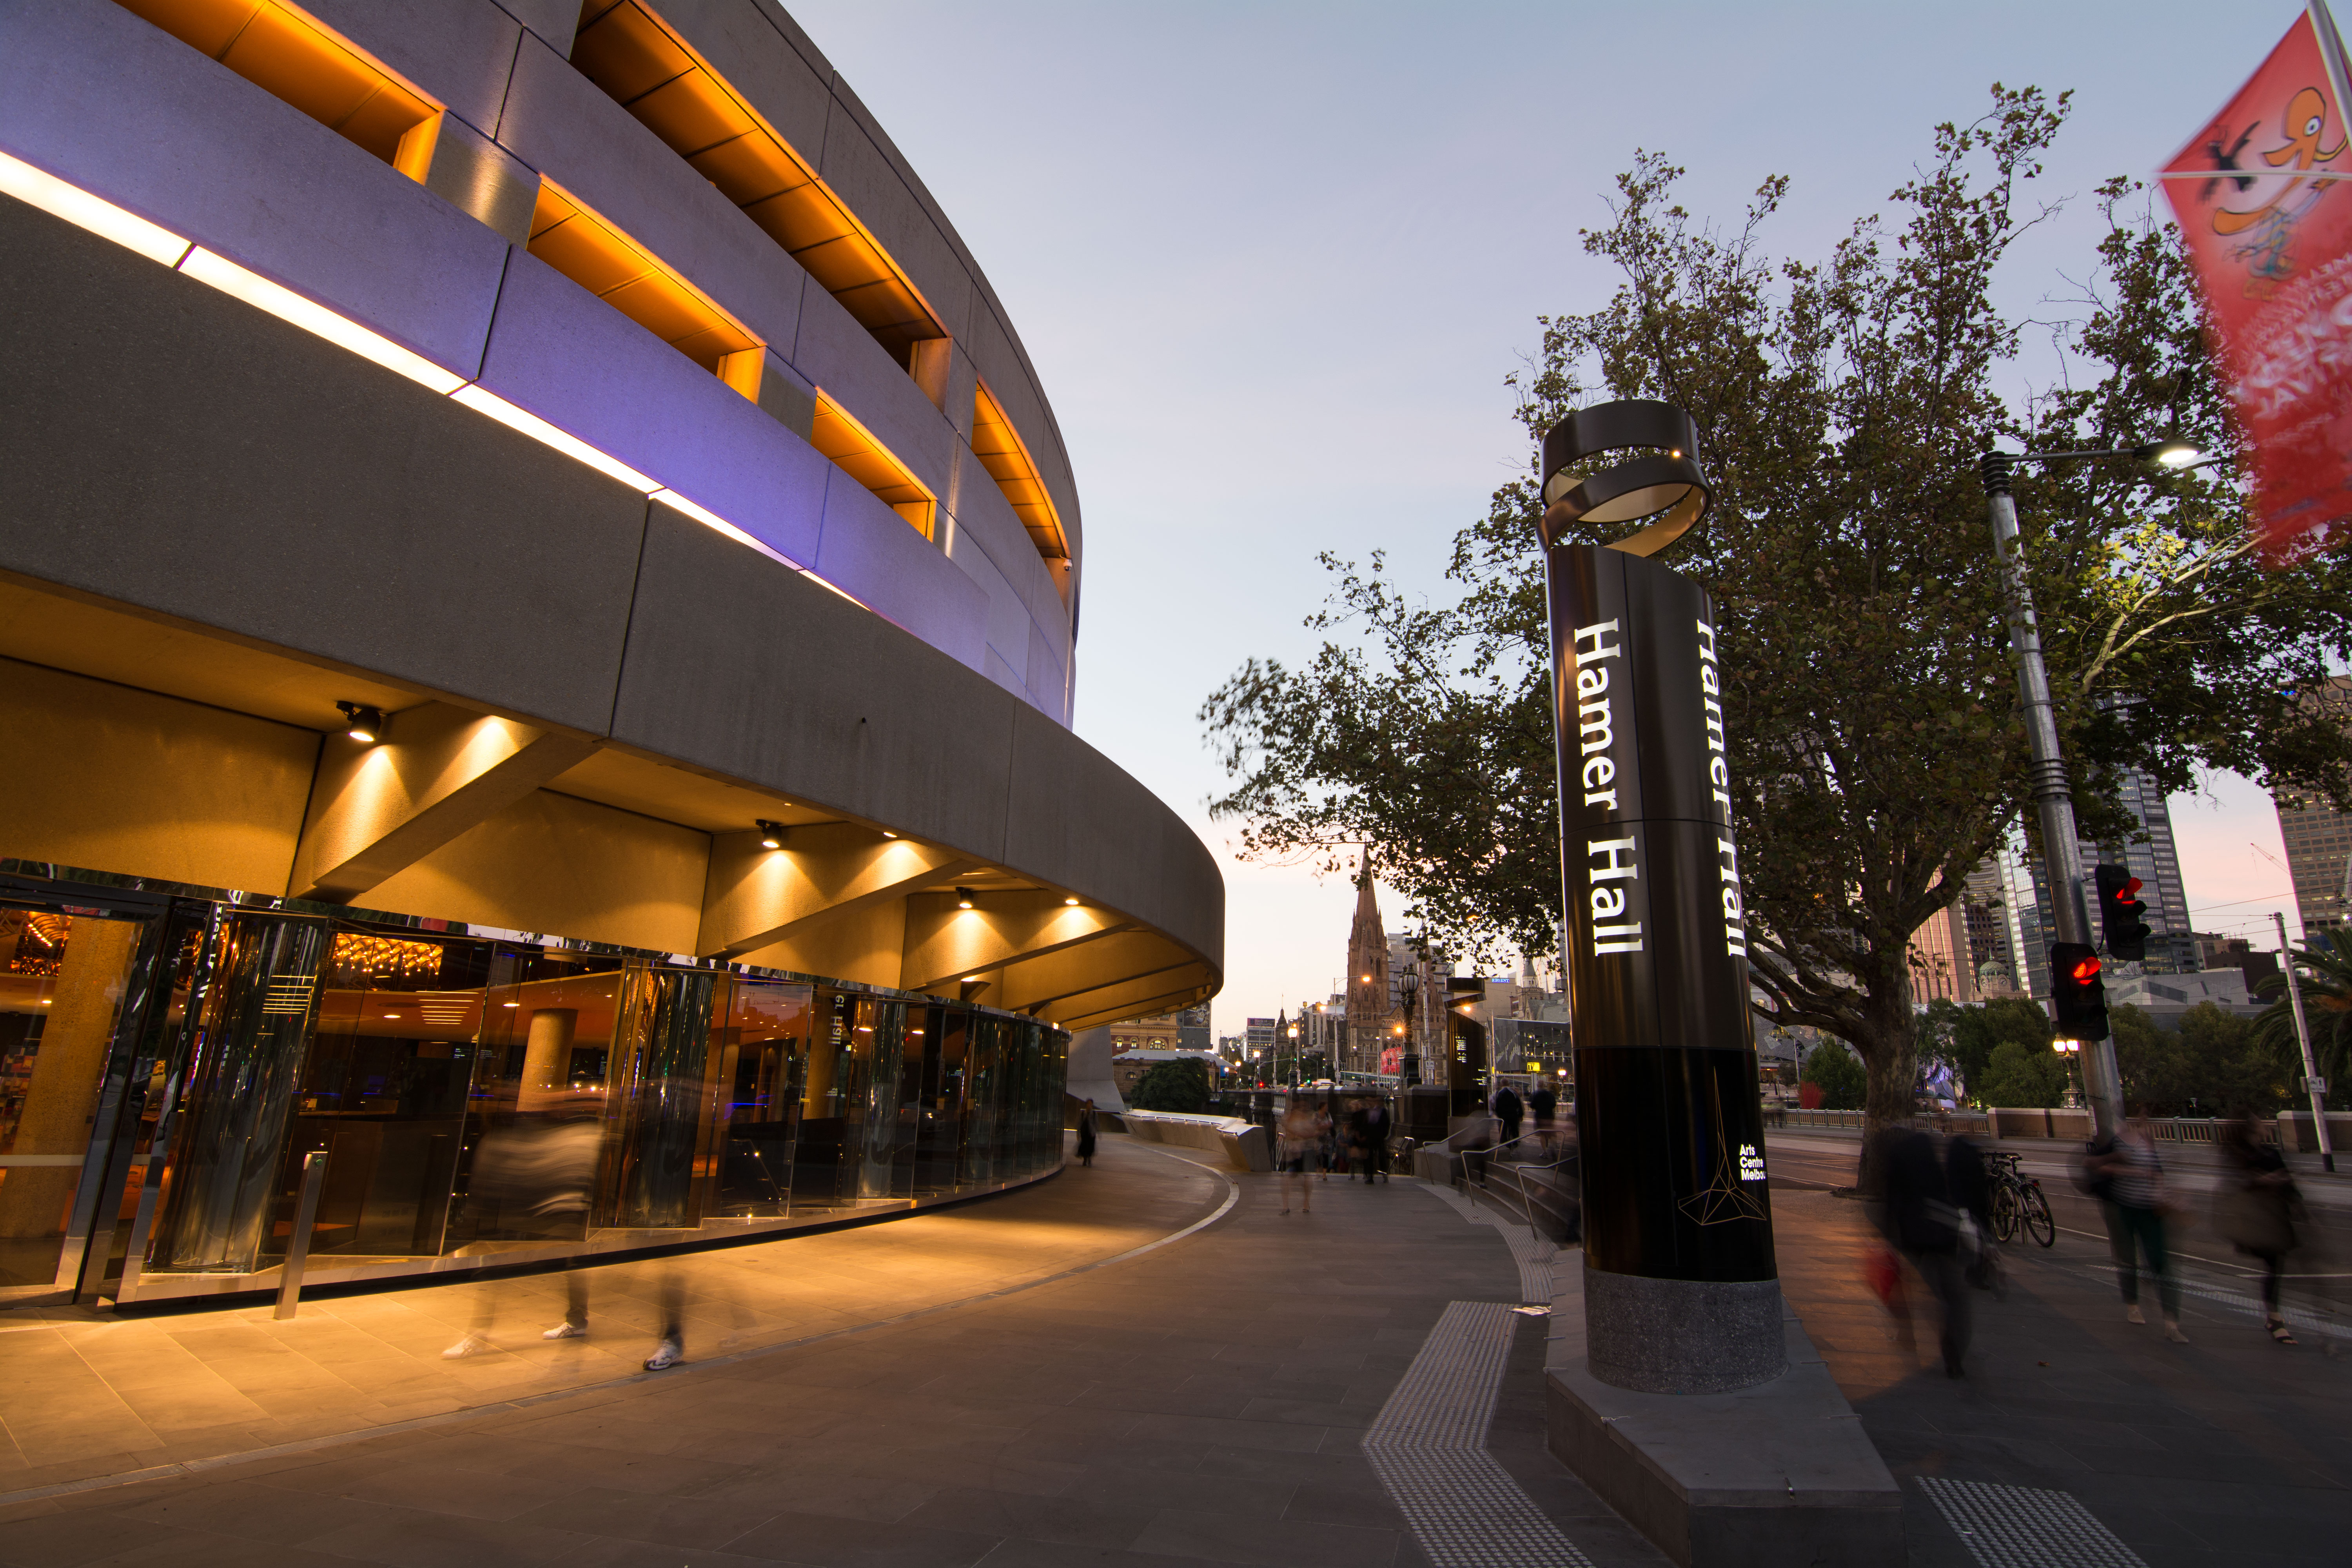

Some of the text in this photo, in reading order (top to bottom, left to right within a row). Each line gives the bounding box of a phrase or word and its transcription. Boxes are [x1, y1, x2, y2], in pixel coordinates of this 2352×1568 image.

[1697, 619, 1732, 815] Hamer
[1574, 617, 1643, 957] Hamer Hall
[1740, 1144, 1755, 1156] Arts
[1740, 1156, 1764, 1168] Centre
[1741, 1169, 1766, 1180] Melbou
